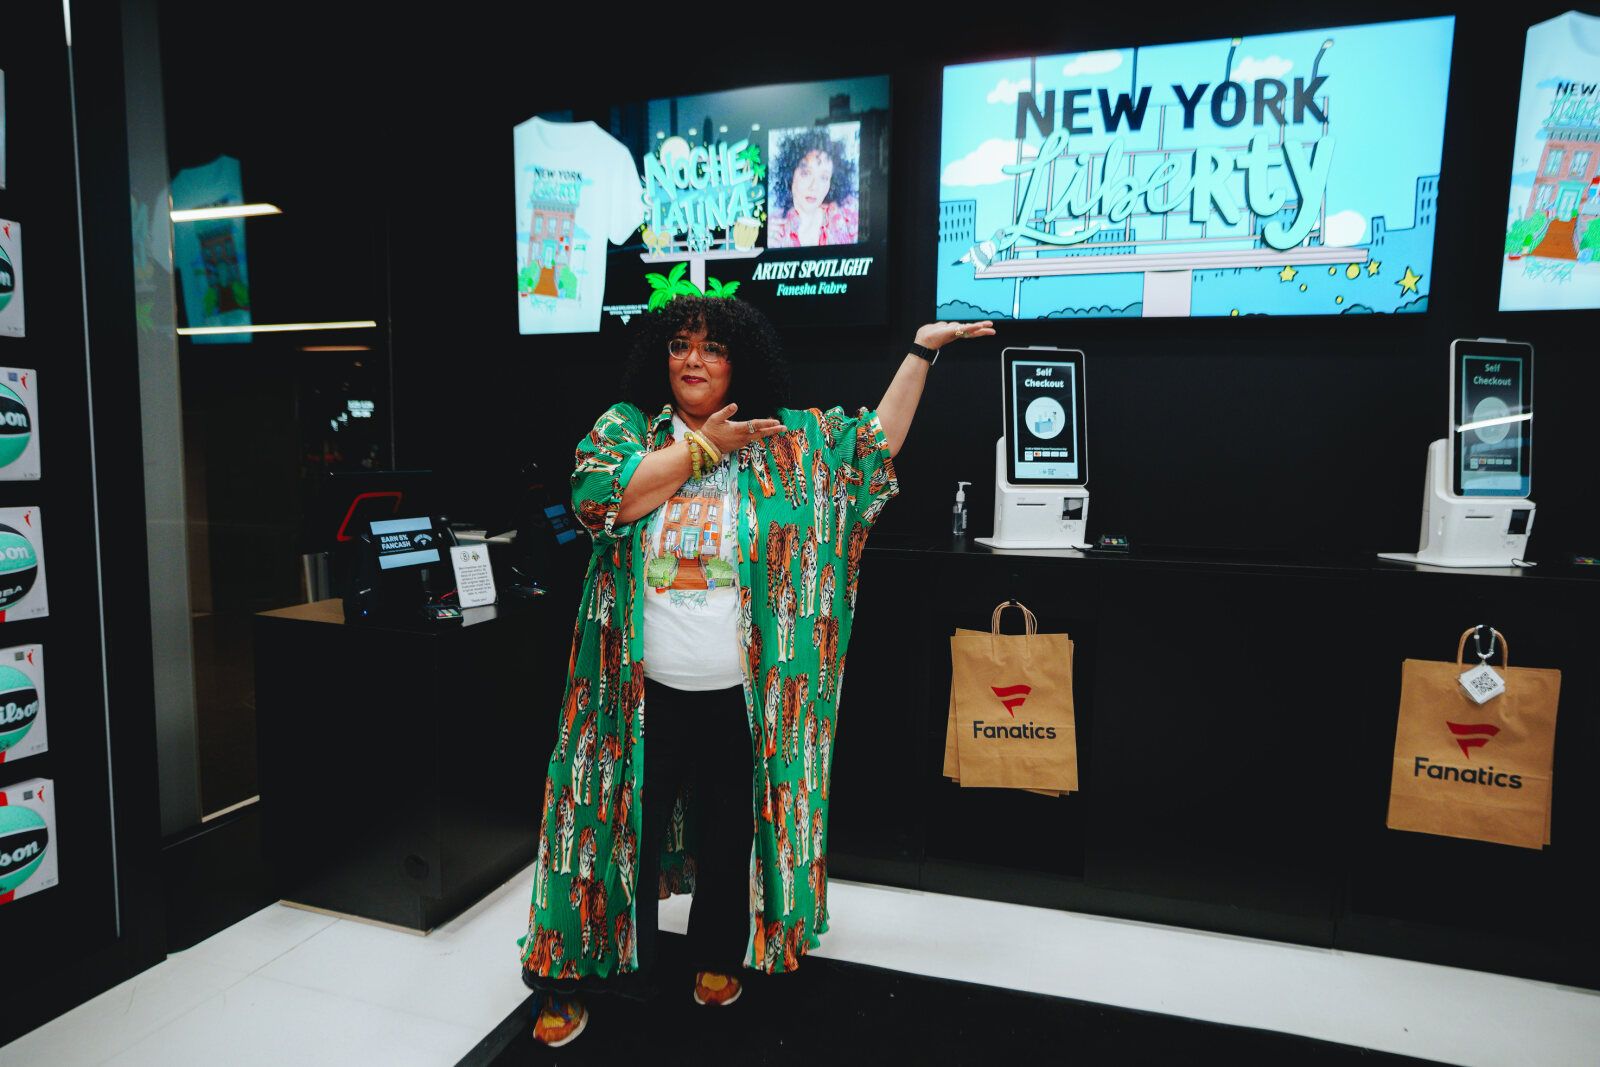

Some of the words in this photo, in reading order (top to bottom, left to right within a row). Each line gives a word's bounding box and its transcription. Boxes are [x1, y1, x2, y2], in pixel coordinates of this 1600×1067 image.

[1556, 81, 1598, 96] NEW
[1015, 86, 1152, 139] NEW
[1173, 75, 1330, 129] YORK
[534, 168, 554, 178] NEW
[558, 170, 583, 182] YORK
[643, 139, 755, 201] NOCHE
[651, 182, 756, 237] LATINA
[751, 260, 799, 281] ARTIST
[798, 257, 873, 279] SPOTLIGHT
[776, 282, 817, 297] Fanesha
[817, 281, 848, 295] Fabre
[1035, 367, 1053, 378] Self
[1485, 363, 1501, 374] Self
[1024, 378, 1065, 389] Checkout
[1473, 376, 1512, 387] Checkout
[381, 541, 412, 551] FANCASH
[972, 720, 1057, 740] Fanatics
[1414, 756, 1523, 790] Fanatics
